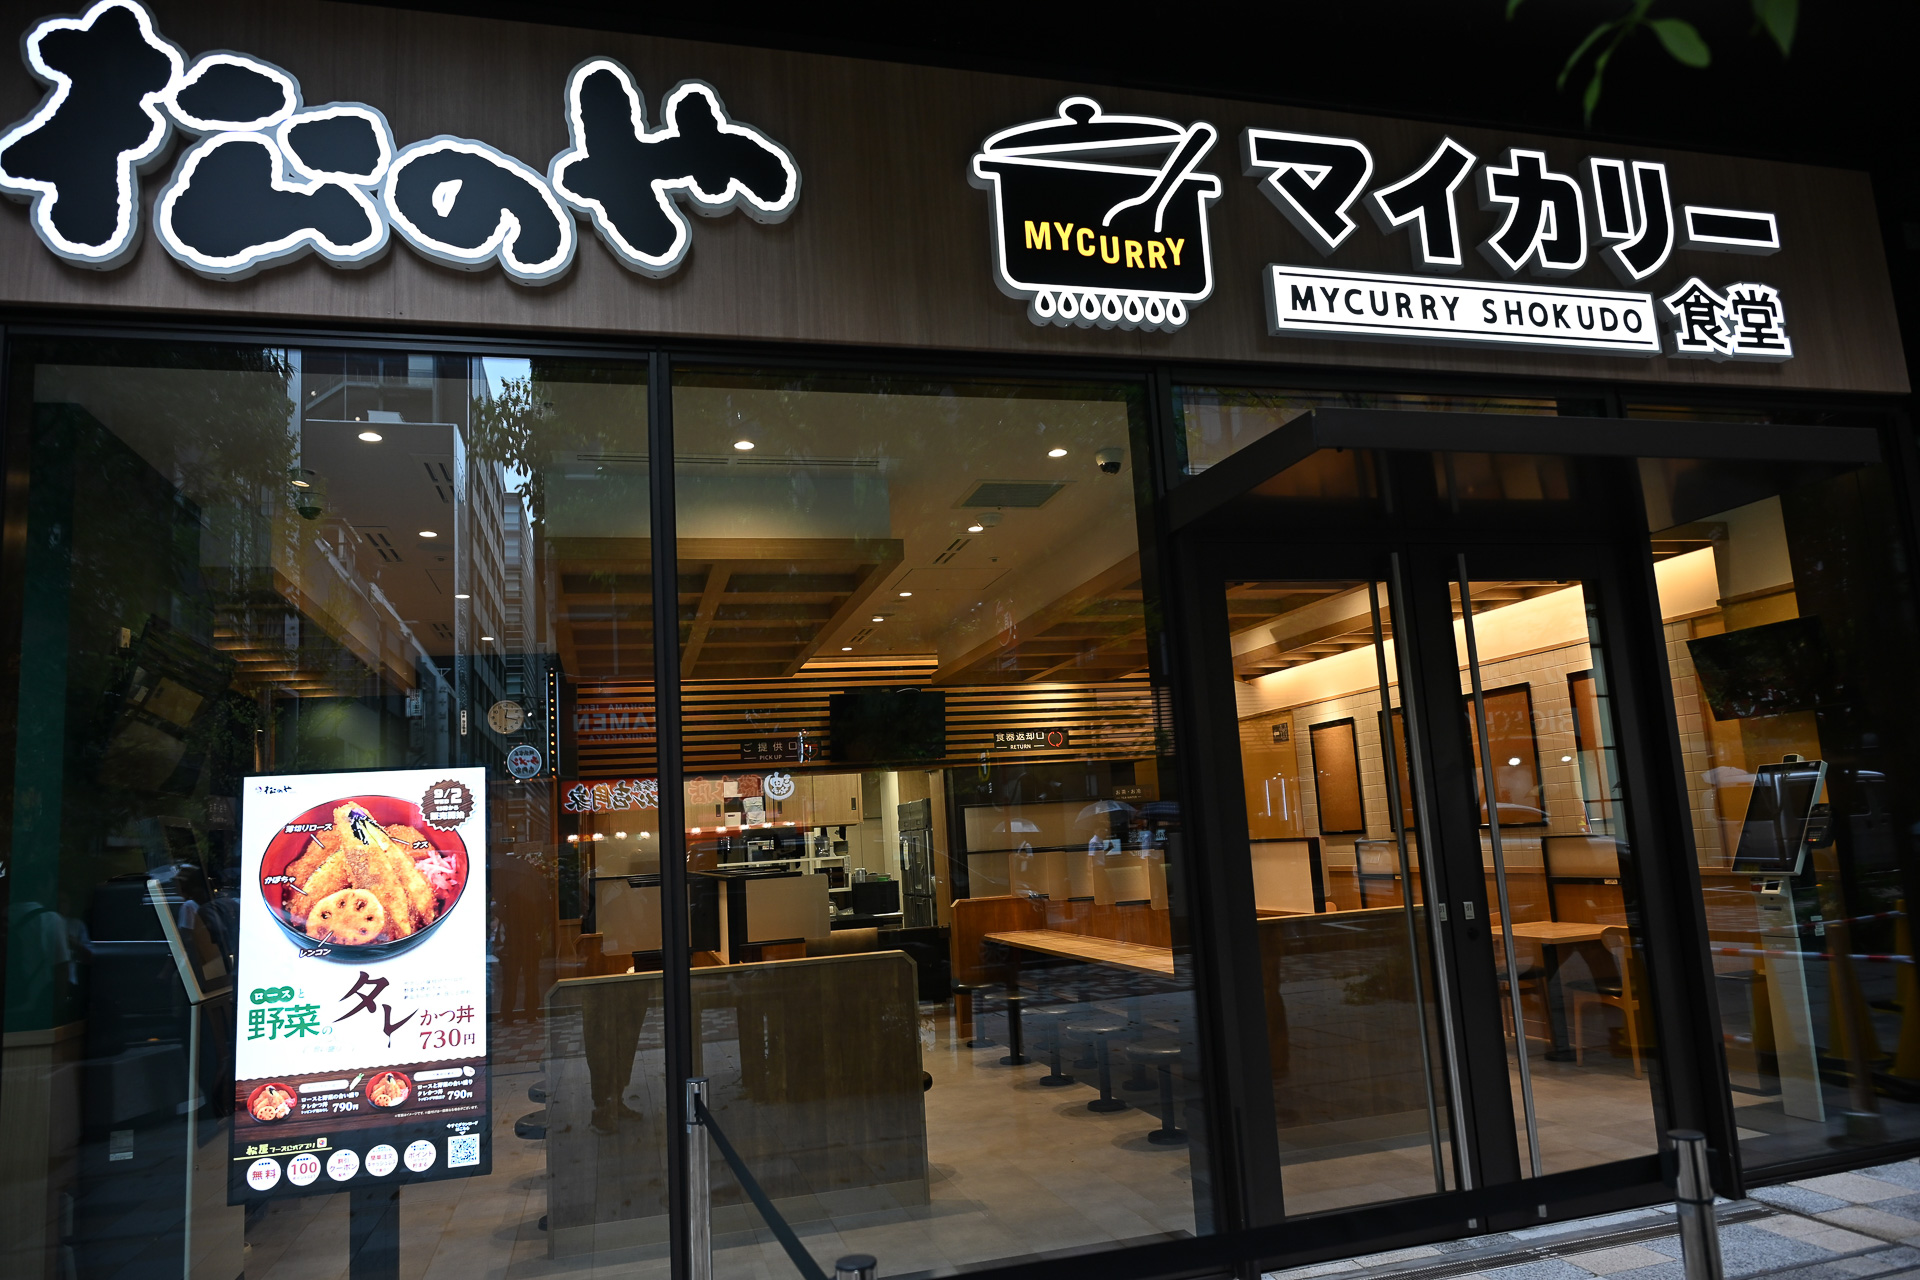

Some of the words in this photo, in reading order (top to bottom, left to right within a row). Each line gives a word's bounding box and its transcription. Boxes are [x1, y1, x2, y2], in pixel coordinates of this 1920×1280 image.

[0, 0, 800, 283] 松のや
[1243, 126, 1780, 282] マイカリー
[1024, 220, 1186, 271] MYCURRY
[1290, 284, 1461, 324] MYCURRY
[1481, 296, 1644, 335] SHOKUDO
[1664, 277, 1794, 363] 食堂
[995, 731, 1045, 742] 食器返却口
[743, 741, 798, 753] ご提供口
[433, 788, 463, 804] 9/2
[413, 841, 429, 849] ナス
[264, 876, 296, 885] かぼちゃ
[299, 948, 331, 958] レンコン
[333, 971, 420, 1048] タレ
[420, 1005, 475, 1026] かつ丼
[420, 1028, 476, 1050] 730円
[447, 1089, 473, 1101] 790円
[332, 1101, 359, 1112] 790円
[408, 1149, 434, 1158] ポイント
[290, 1162, 317, 1175] 100
[329, 1164, 357, 1173] クーポン
[252, 1169, 277, 1181] 無料
